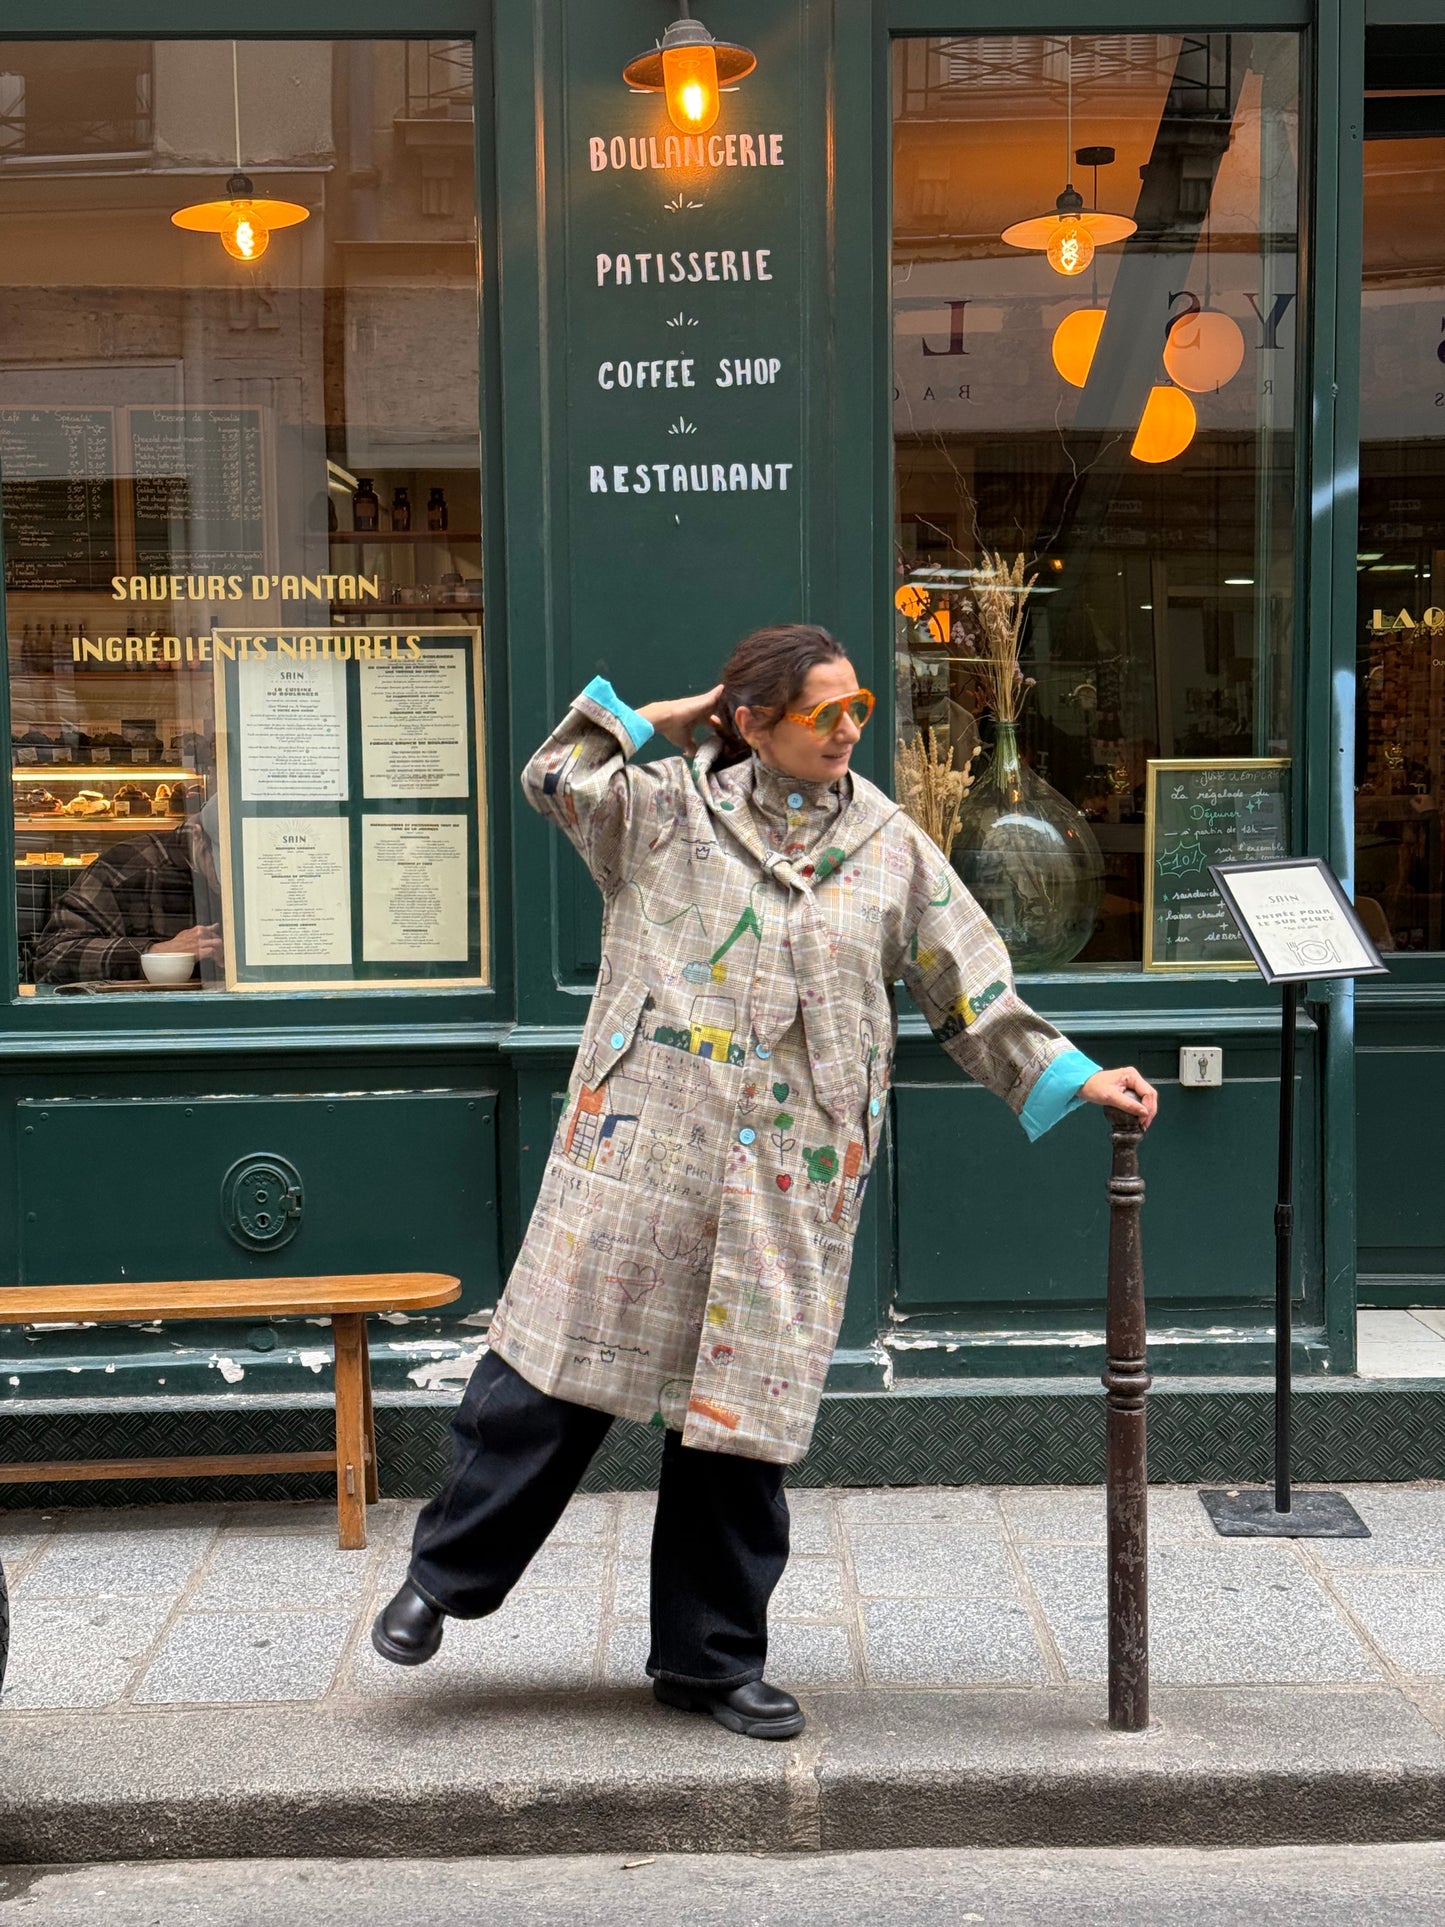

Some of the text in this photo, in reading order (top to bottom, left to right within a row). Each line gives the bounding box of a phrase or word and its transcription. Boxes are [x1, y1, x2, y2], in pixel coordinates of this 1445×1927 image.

[589, 133, 784, 172] BOULANGERIE
[596, 250, 773, 287] PATISSERIE
[598, 358, 781, 390] COFFEE SHOP
[590, 463, 793, 494] RESTAURANT
[252, 574, 379, 601] D'ANTAN
[1373, 608, 1416, 629] LA
[72, 631, 422, 663] INGRÉDIENTS NATURELS
[280, 671, 304, 680] SAIN
[1171, 785, 1269, 806] La régalade du
[1190, 805, 1242, 826] Déjeuner
[282, 835, 307, 843] SAIN
[1194, 828, 1223, 840] partir
[1226, 825, 1237, 834] de
[1214, 841, 1285, 854] sur l'ensemble
[1221, 853, 1237, 862] de
[1268, 895, 1300, 903] SAIN
[1197, 910, 1226, 919] chaude
[1256, 911, 1296, 919] ENTRÉE
[1175, 935, 1191, 943] un
